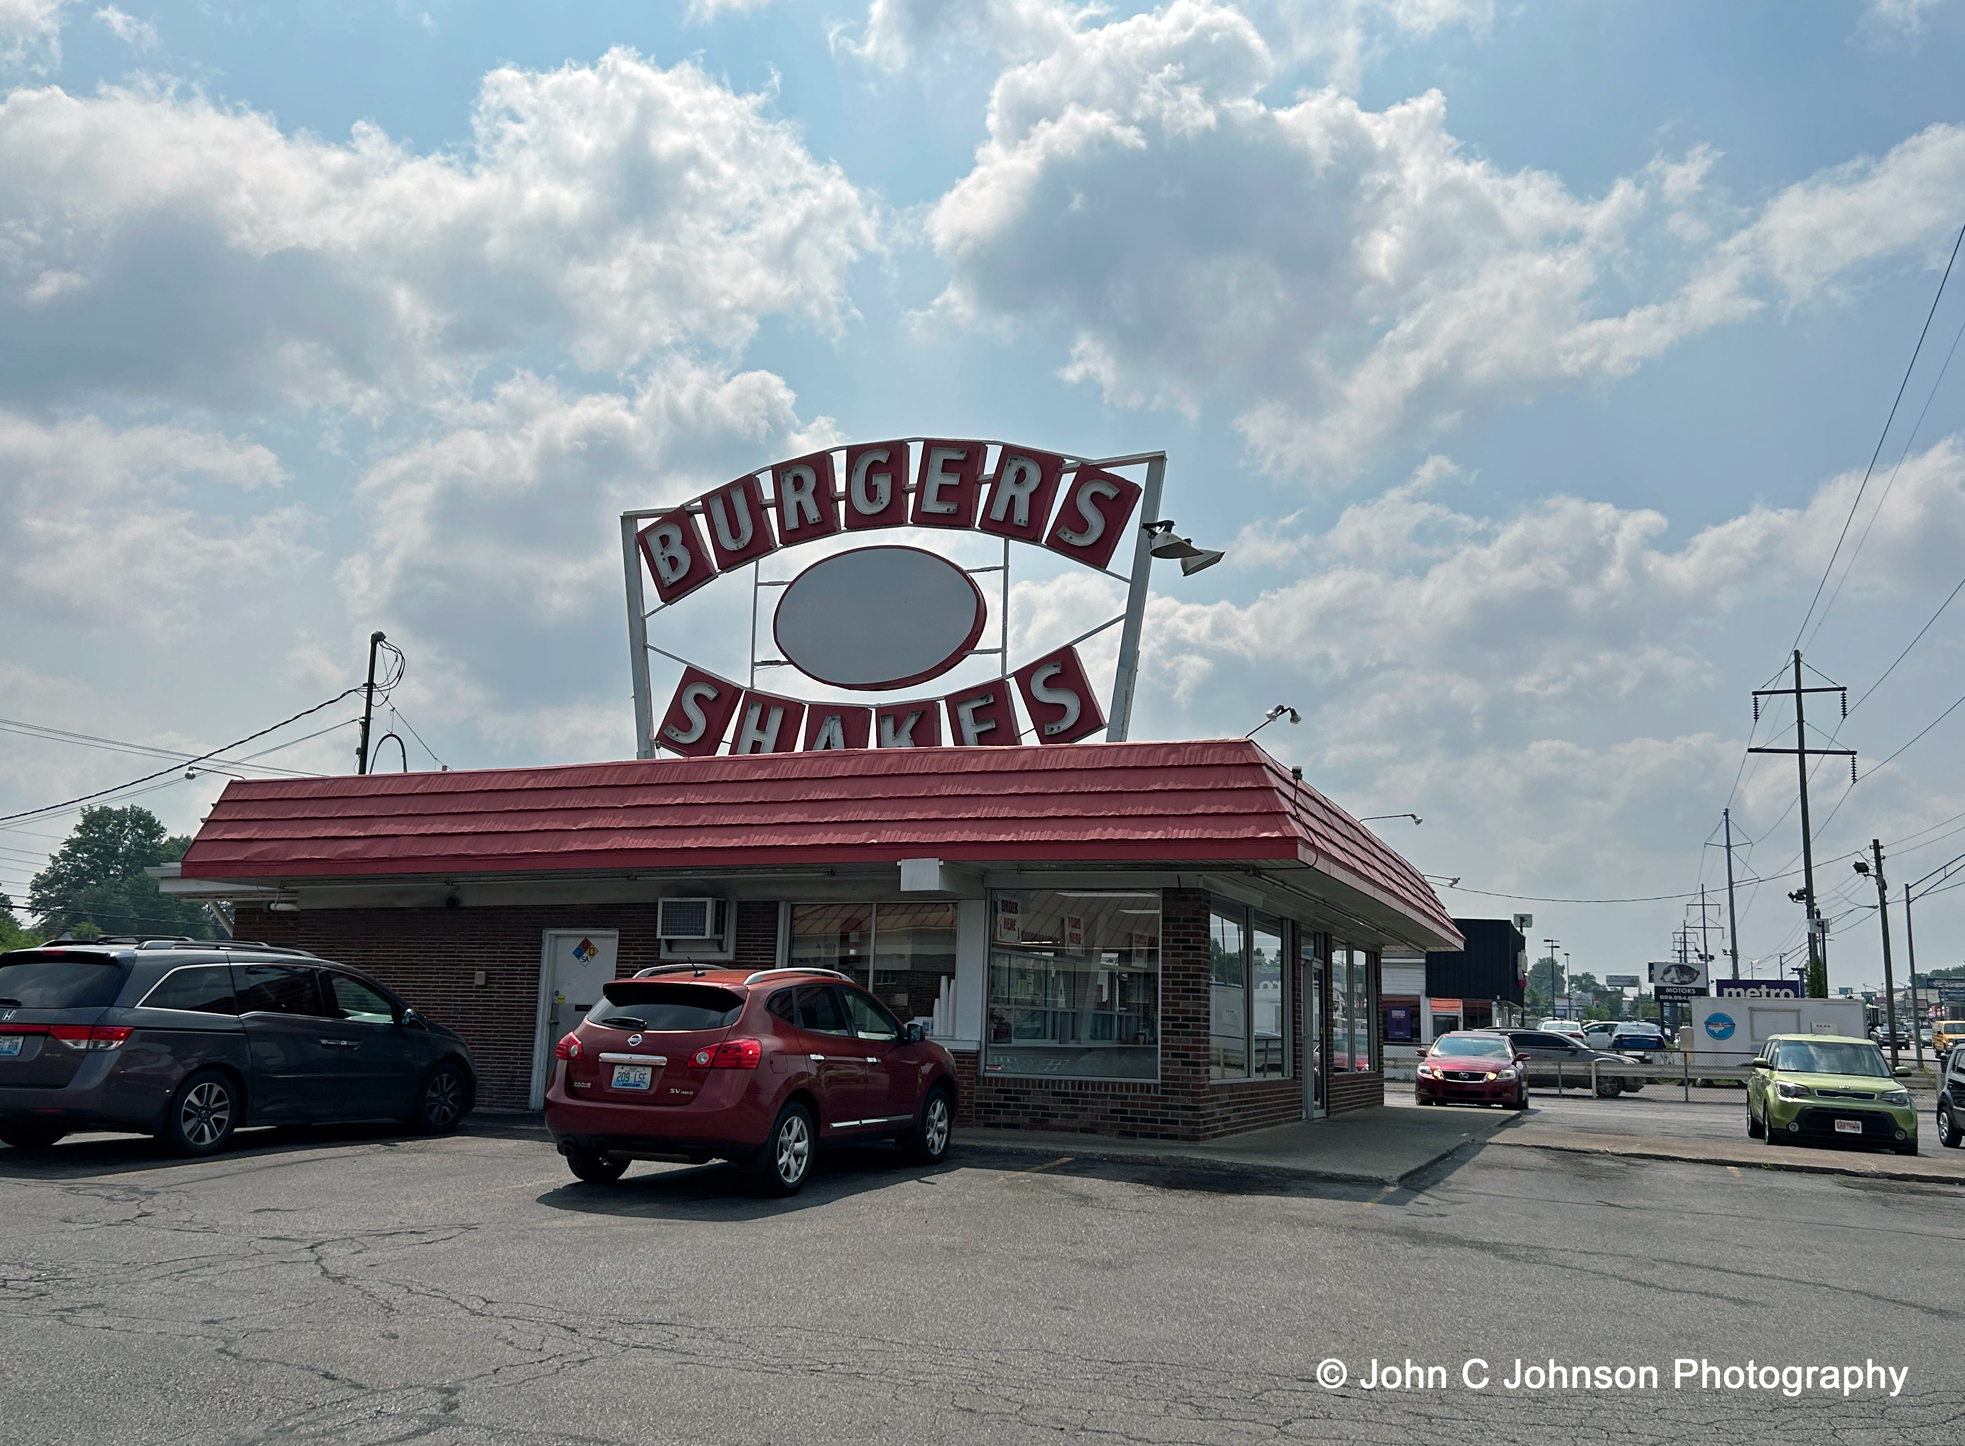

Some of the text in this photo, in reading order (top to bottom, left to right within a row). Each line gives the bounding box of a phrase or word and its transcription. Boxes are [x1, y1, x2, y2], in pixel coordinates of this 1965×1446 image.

[646, 447, 1120, 588] BURGERS
[663, 661, 1081, 754] SHAKES
[1003, 917, 1016, 931] HERE
[1069, 932, 1081, 945] HERE
[589, 947, 595, 956] 0
[1723, 984, 1795, 998] metro
[616, 1071, 647, 1084] 209 LSE
